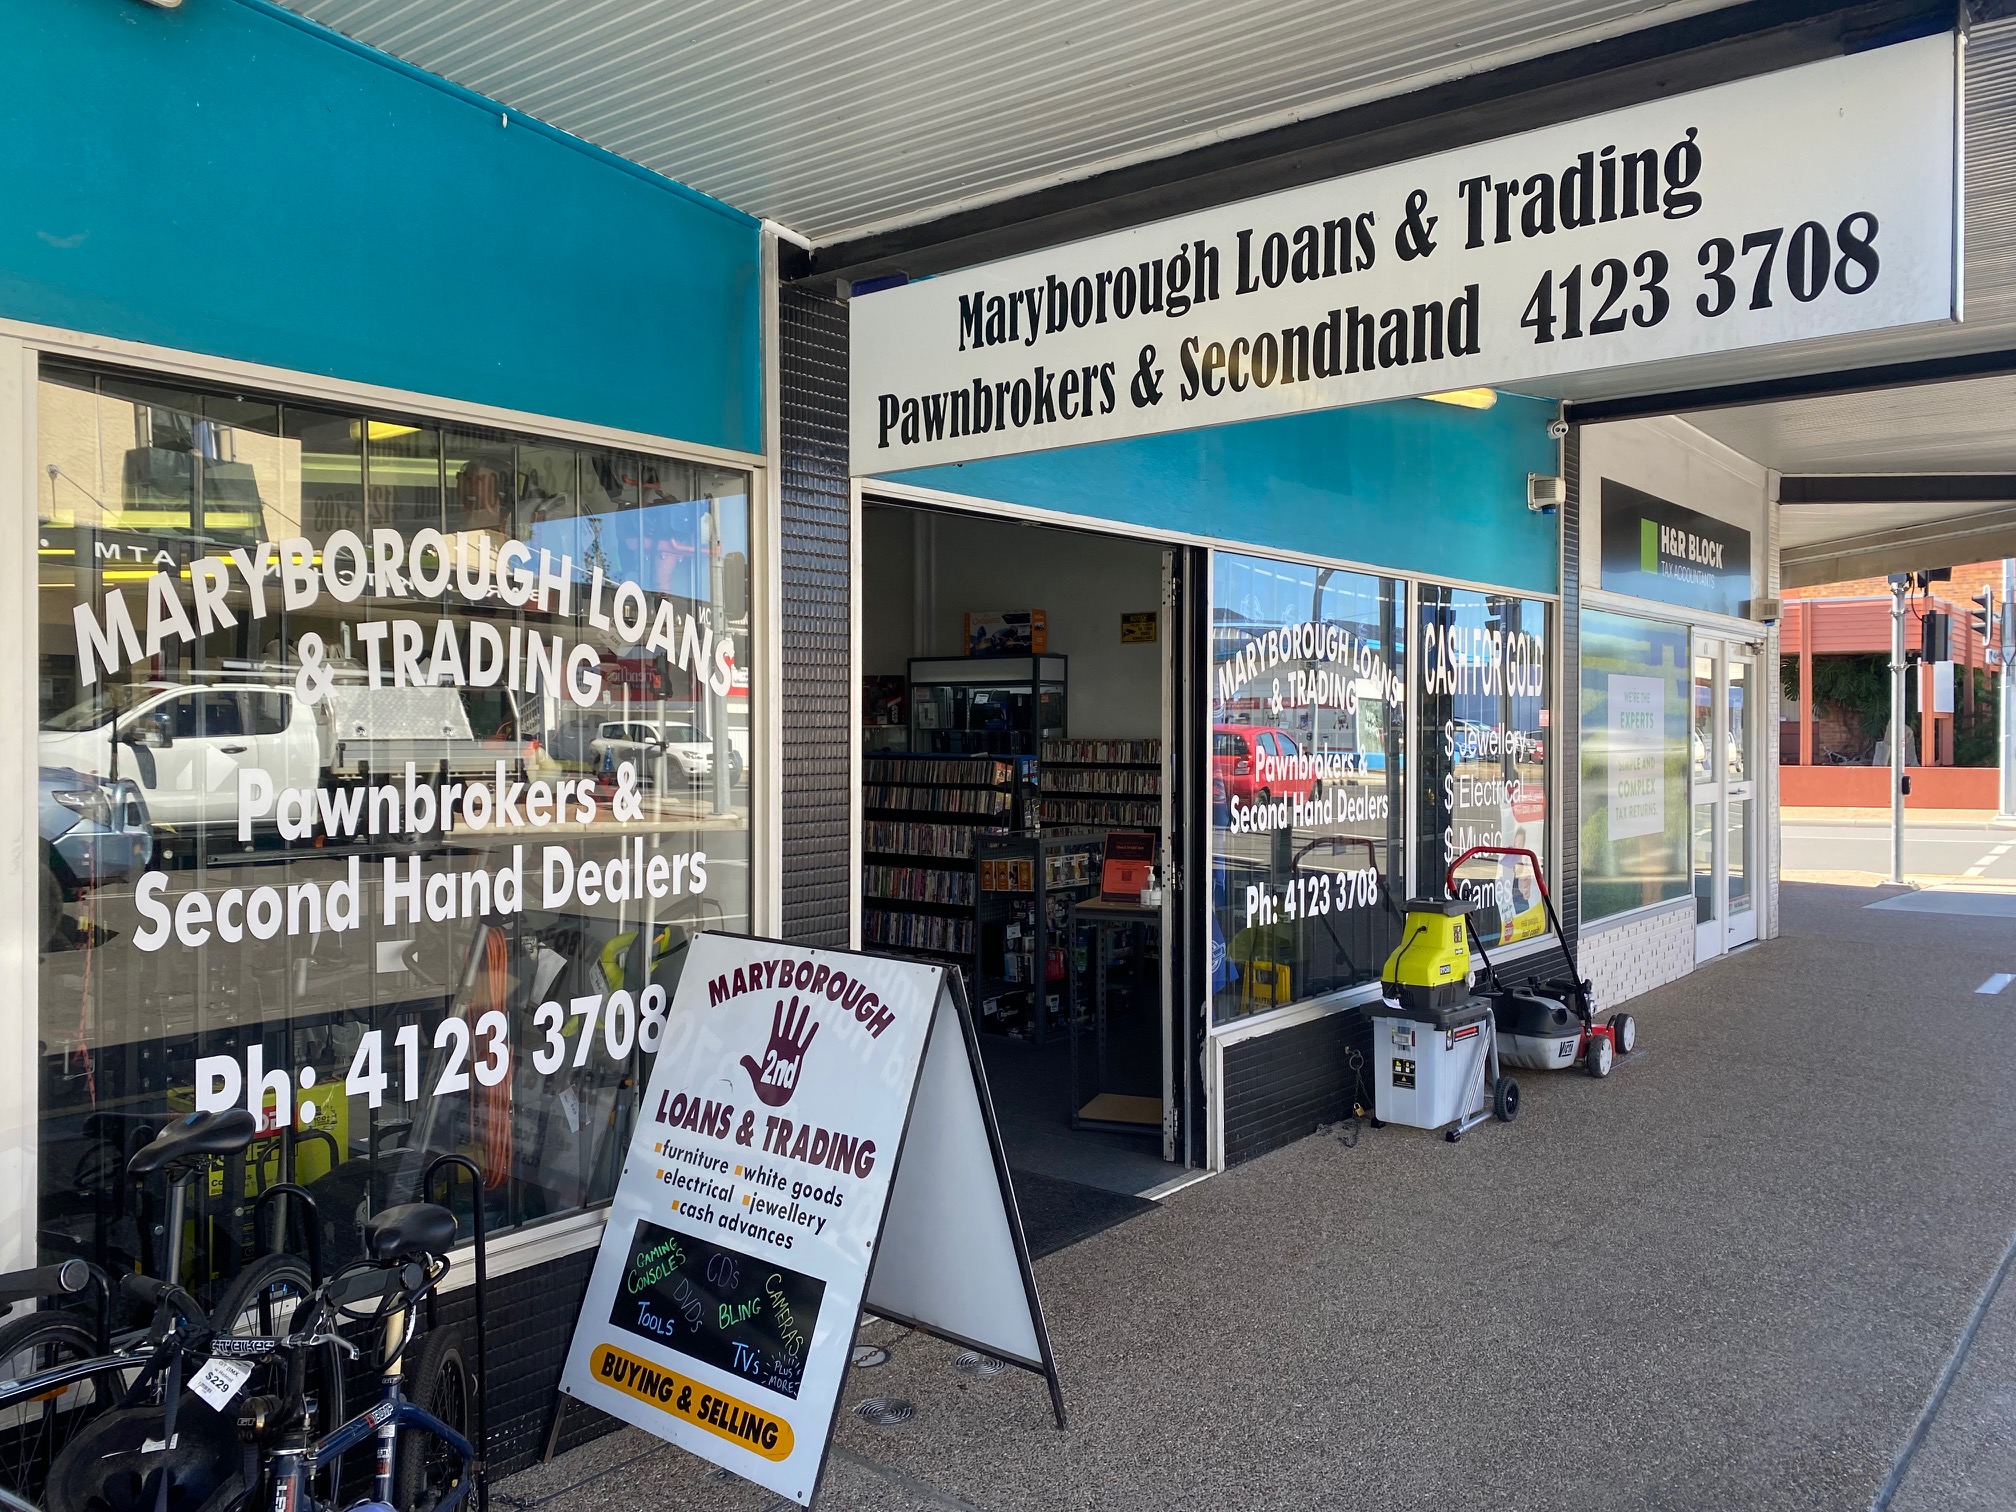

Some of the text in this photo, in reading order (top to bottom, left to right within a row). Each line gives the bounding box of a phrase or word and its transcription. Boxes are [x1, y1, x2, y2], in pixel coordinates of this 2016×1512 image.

[958, 126, 1703, 352] Maryborough Loans & Trading
[877, 210, 1881, 448] Pawnbrokers & Secondhand 4123 3708
[1661, 524, 1723, 569] H&R BLOCK
[1661, 561, 1716, 590] TAX ACCOUNTANTS
[73, 527, 734, 699] MARYBOROUGH LOANS
[296, 620, 603, 707] & TRADING
[1218, 622, 1399, 709] MARYBOROUGH LOANS
[1424, 622, 1544, 698] CASH FOR GOLD
[1271, 669, 1357, 716] & TRADING
[1444, 719, 1527, 768] $ Jewellery
[1620, 711, 1654, 729] EXPERTS
[1255, 743, 1368, 783] Pawnbrokers &
[1642, 756, 1655, 770] AND
[237, 760, 645, 843] Pawnbrokers &
[1230, 785, 1389, 834] Second Hand Dealers
[1444, 773, 1525, 816] $ Electrical
[1618, 778, 1656, 798] COMPLEX
[1615, 806, 1628, 821] TAX
[1444, 824, 1503, 868] $ Music
[132, 829, 708, 951] Second Hand Dealers
[1246, 867, 1378, 929] Ph: 4123 3708
[1459, 878, 1512, 912] Games
[708, 959, 896, 1040] MARYBOROUGH
[195, 984, 667, 1132] Ph: 4123 3708
[760, 1050, 801, 1090] 2nd
[655, 1089, 877, 1179] LOANS & TRADING
[662, 1139, 844, 1208] furniture white goods
[663, 1168, 827, 1236] electrical jewellery
[679, 1201, 795, 1250] cash advances
[627, 1247, 686, 1294] CONSOLES
[636, 1236, 678, 1268] GAMING
[637, 1301, 675, 1337] TOOLS
[718, 1297, 762, 1330] BLING
[765, 1273, 804, 1358] CAMERAS
[205, 1371, 230, 1393] $229
[774, 1359, 793, 1378] PLUS
[600, 1351, 779, 1451] BUYING & SELLING
